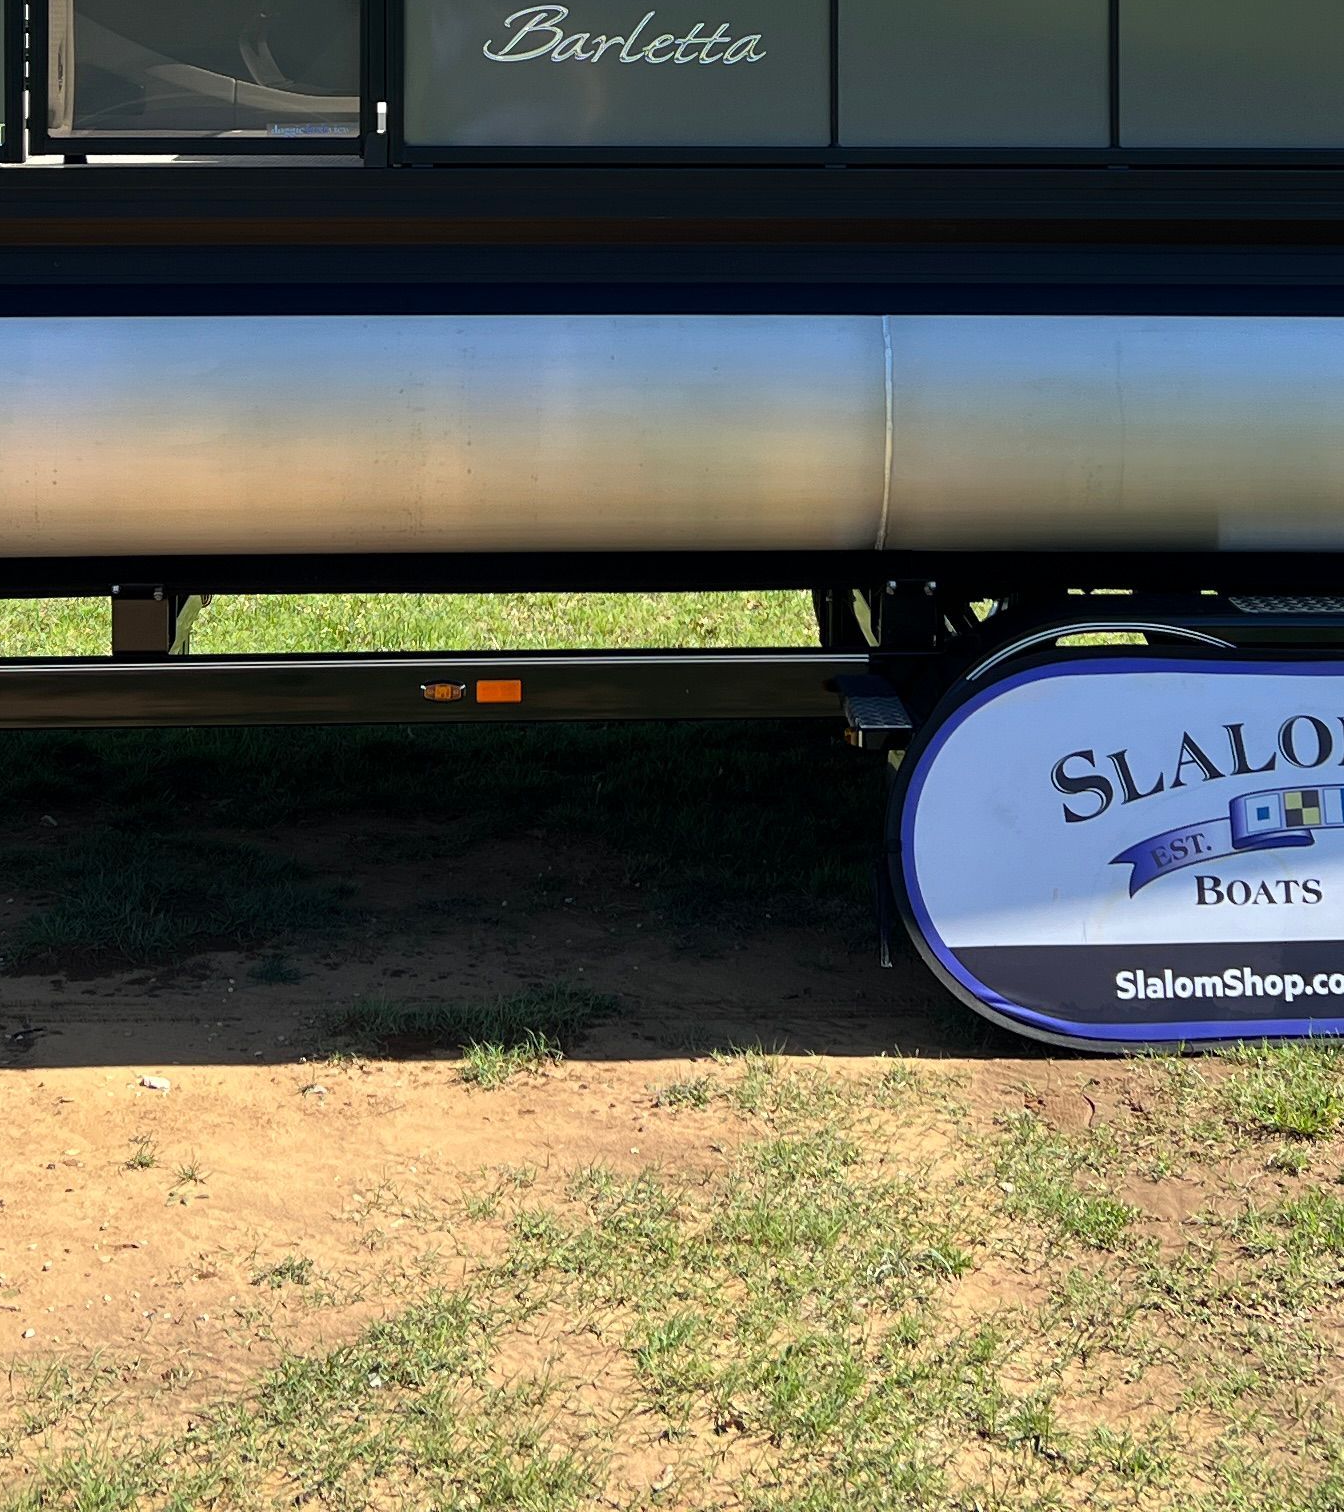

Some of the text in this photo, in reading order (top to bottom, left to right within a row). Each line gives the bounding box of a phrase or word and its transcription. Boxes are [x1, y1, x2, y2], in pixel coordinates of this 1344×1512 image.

[483, 4, 767, 65] Barletta
[1149, 832, 1212, 869] EST.
[1194, 874, 1323, 905] BOATS
